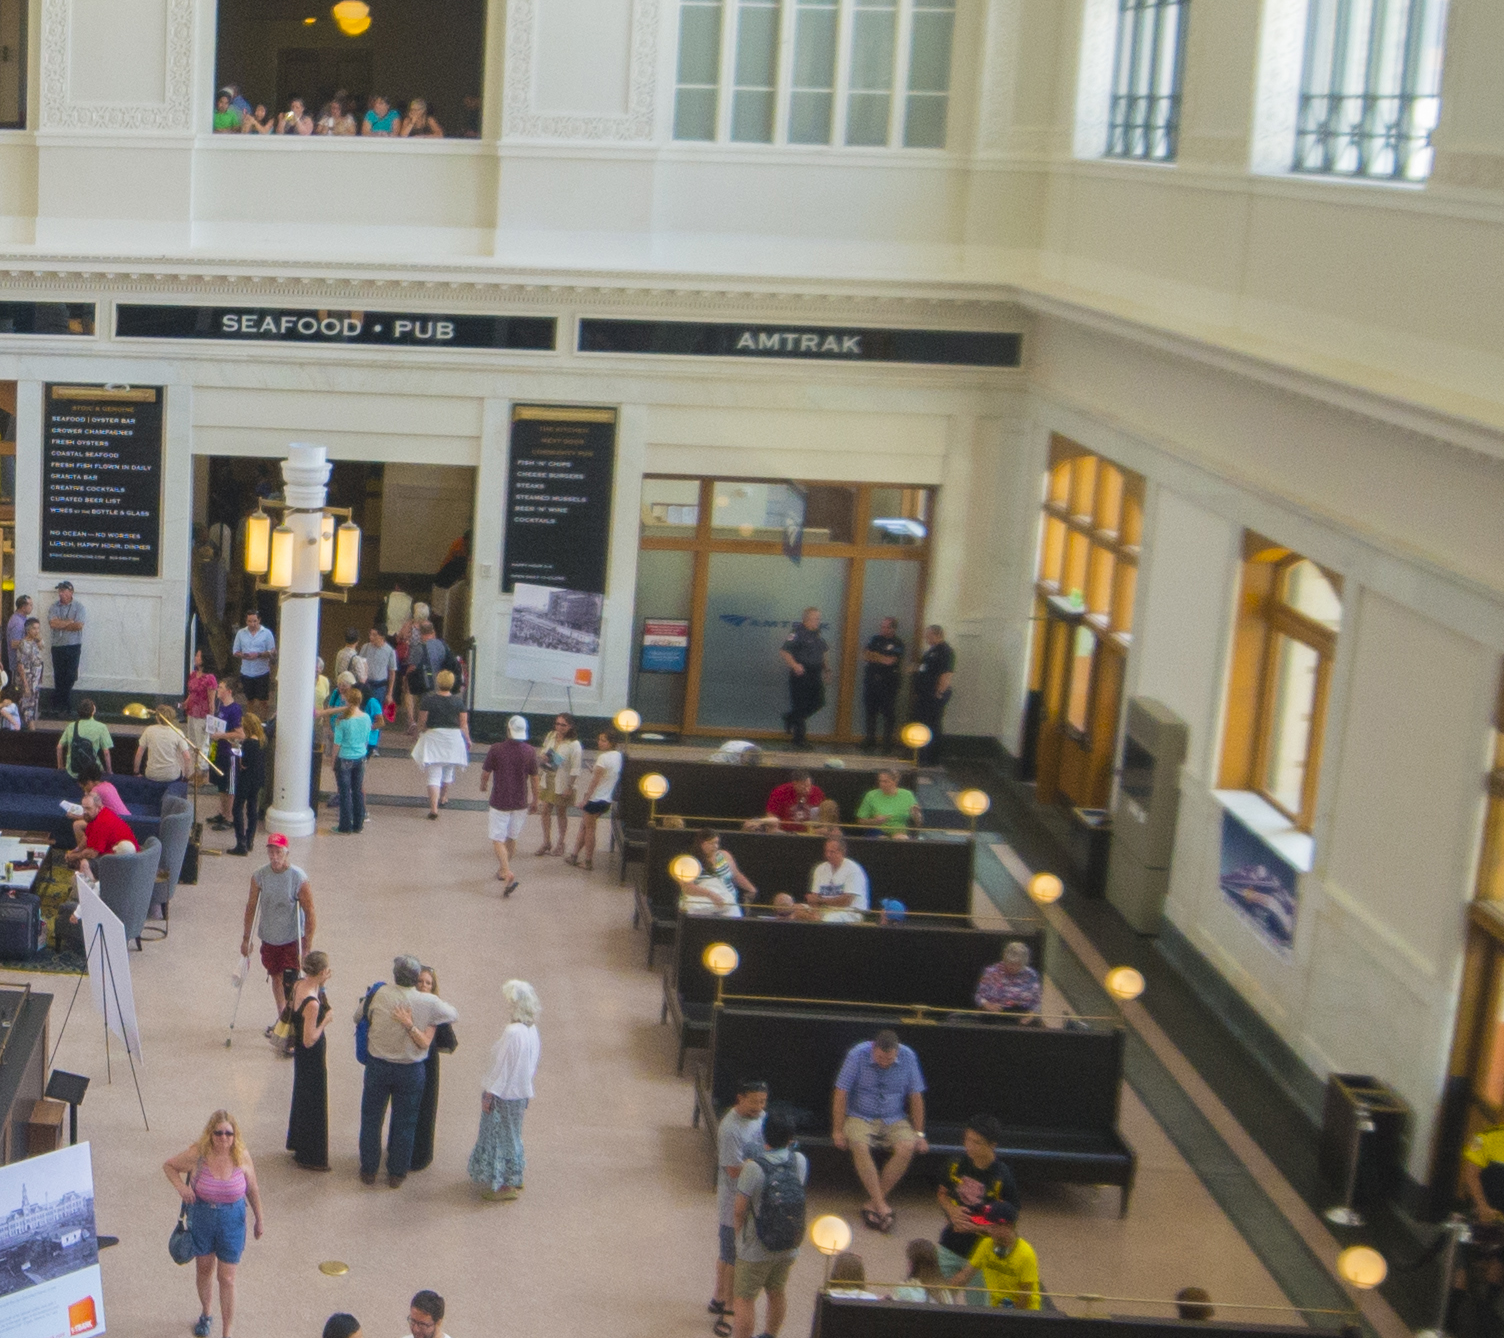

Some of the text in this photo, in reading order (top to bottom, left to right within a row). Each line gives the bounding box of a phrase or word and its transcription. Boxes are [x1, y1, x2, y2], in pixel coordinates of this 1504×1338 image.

[222, 314, 455, 340] SEAFOOD PUB
[736, 331, 861, 353] AMTRAK
[76, 439, 109, 447] OYSTERS
[548, 472, 584, 480] BURGERS
